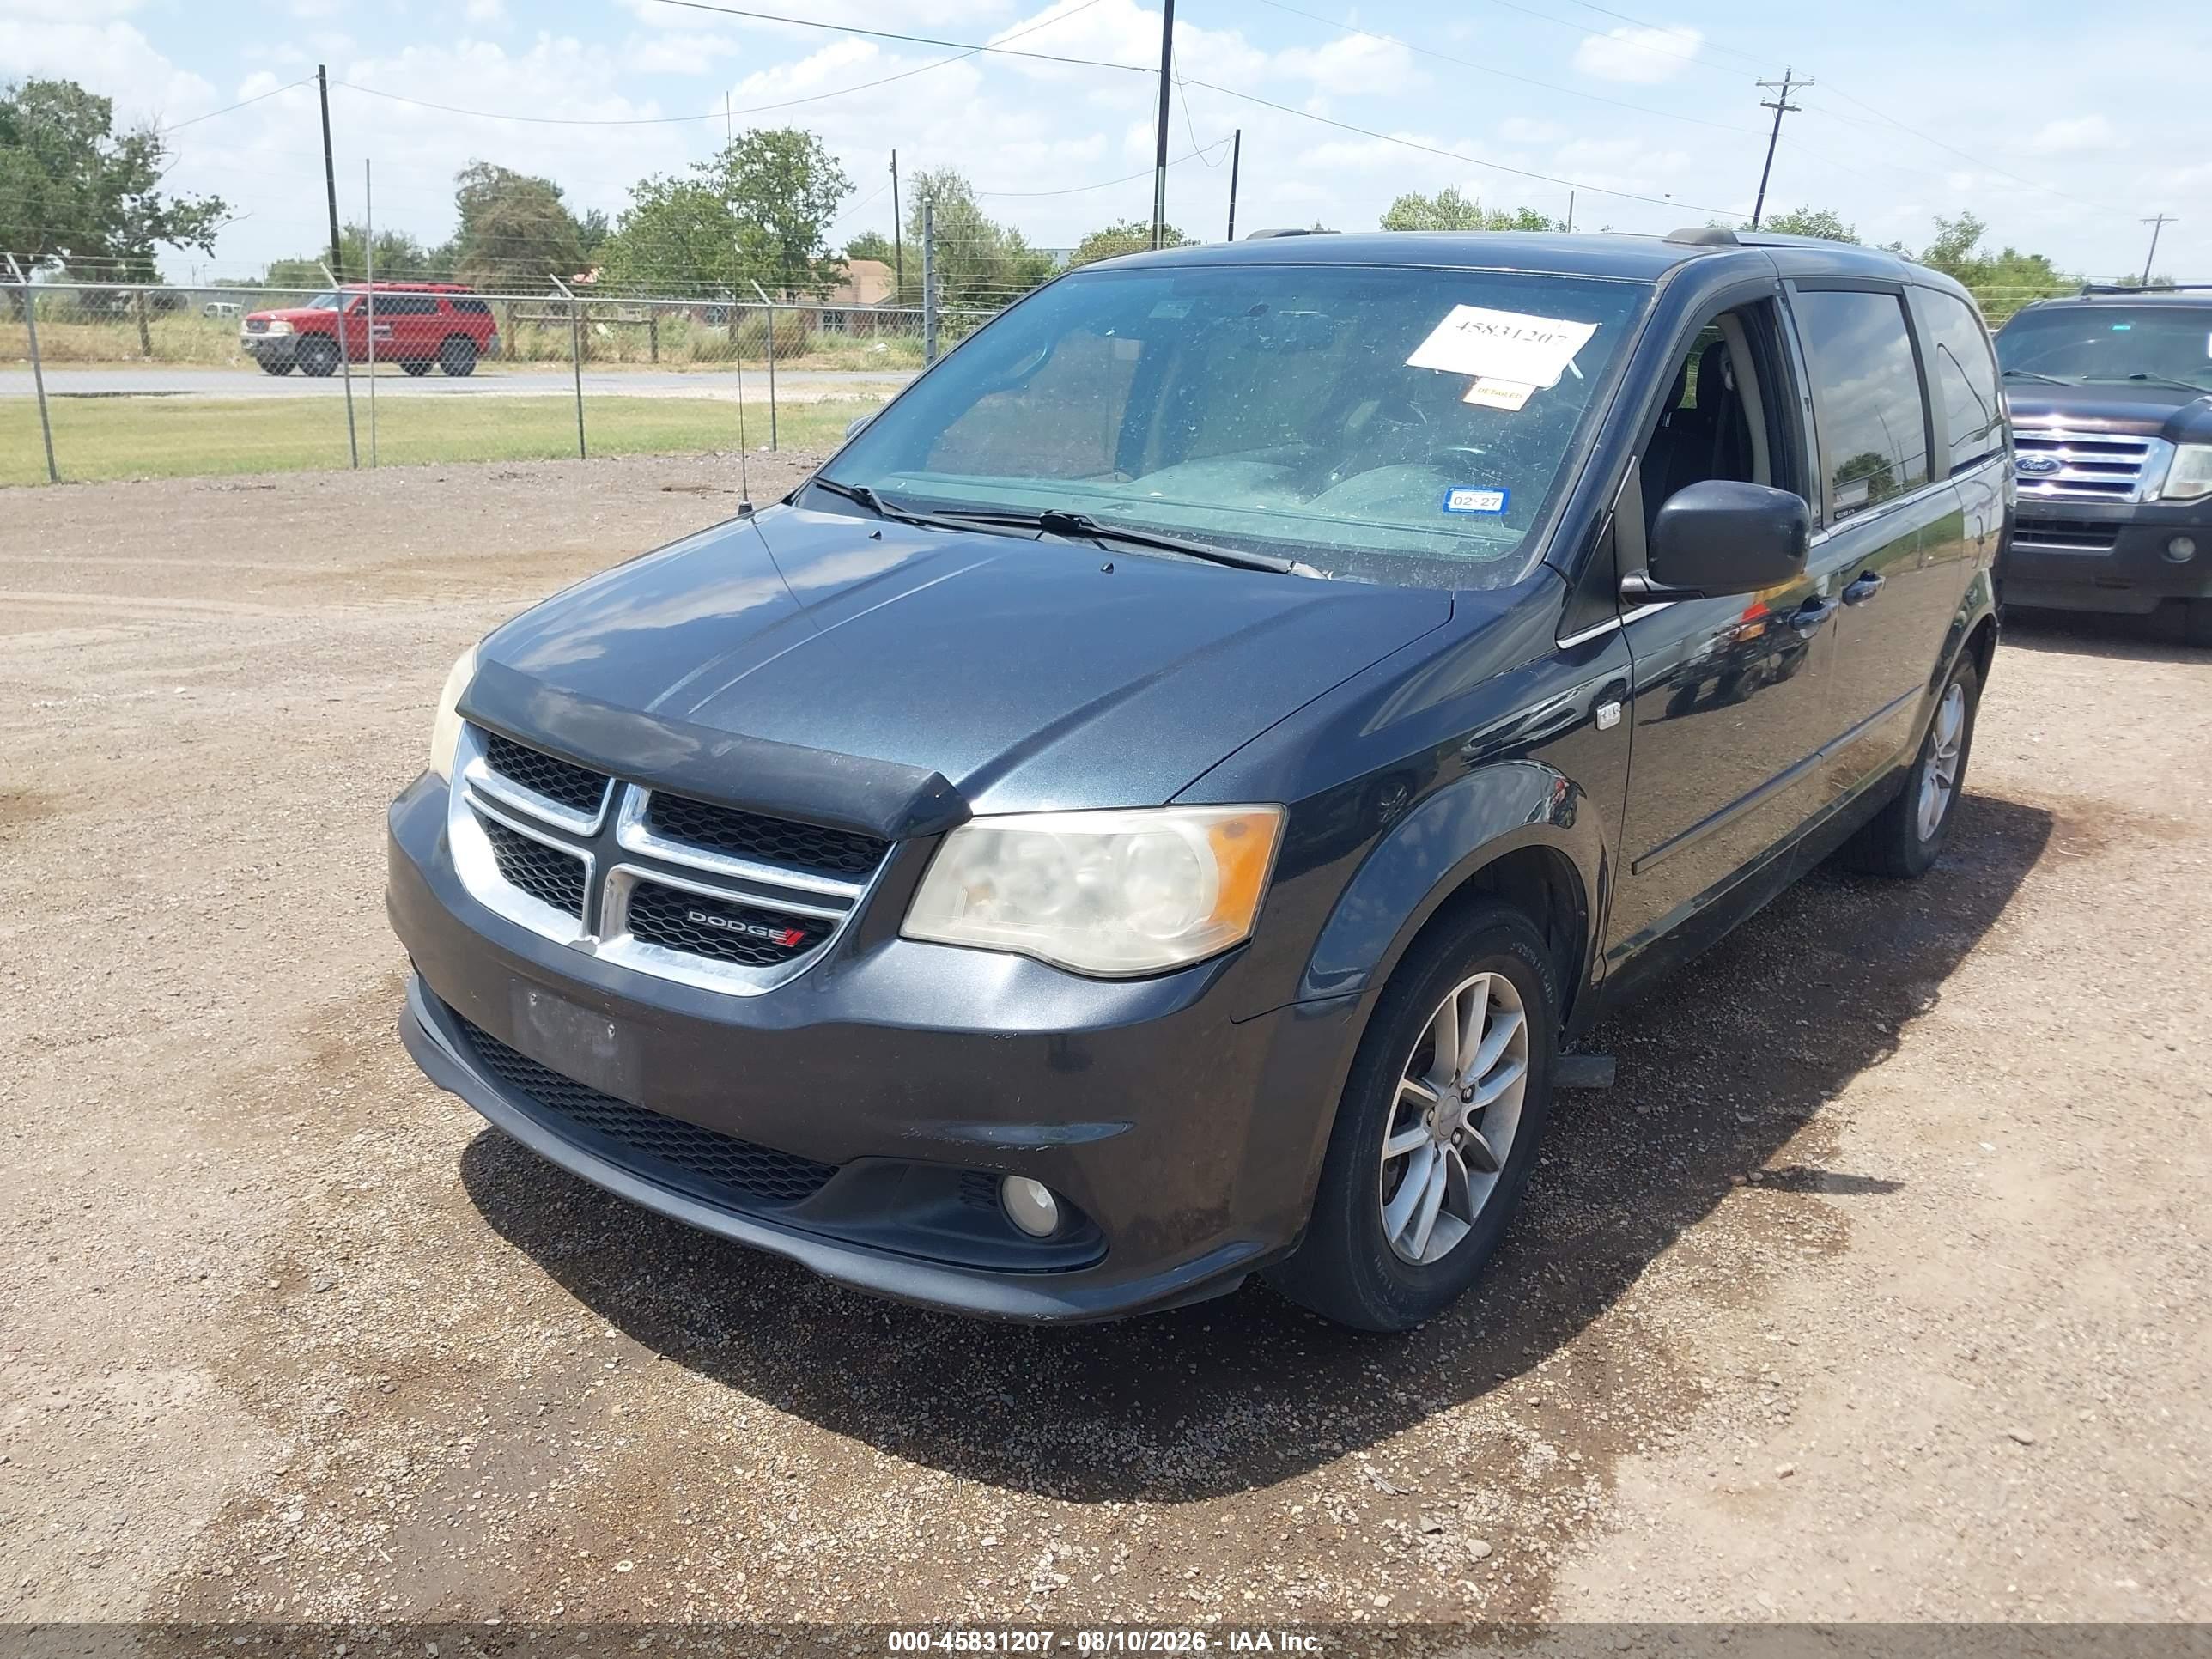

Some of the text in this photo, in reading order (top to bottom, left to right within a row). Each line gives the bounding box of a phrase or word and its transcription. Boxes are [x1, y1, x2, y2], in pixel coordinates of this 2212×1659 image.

[1455, 320, 1570, 346] 45831207
[1477, 386, 1522, 400] DETAILED
[2022, 457, 2050, 470] Ford
[687, 911, 788, 941] DODGE
